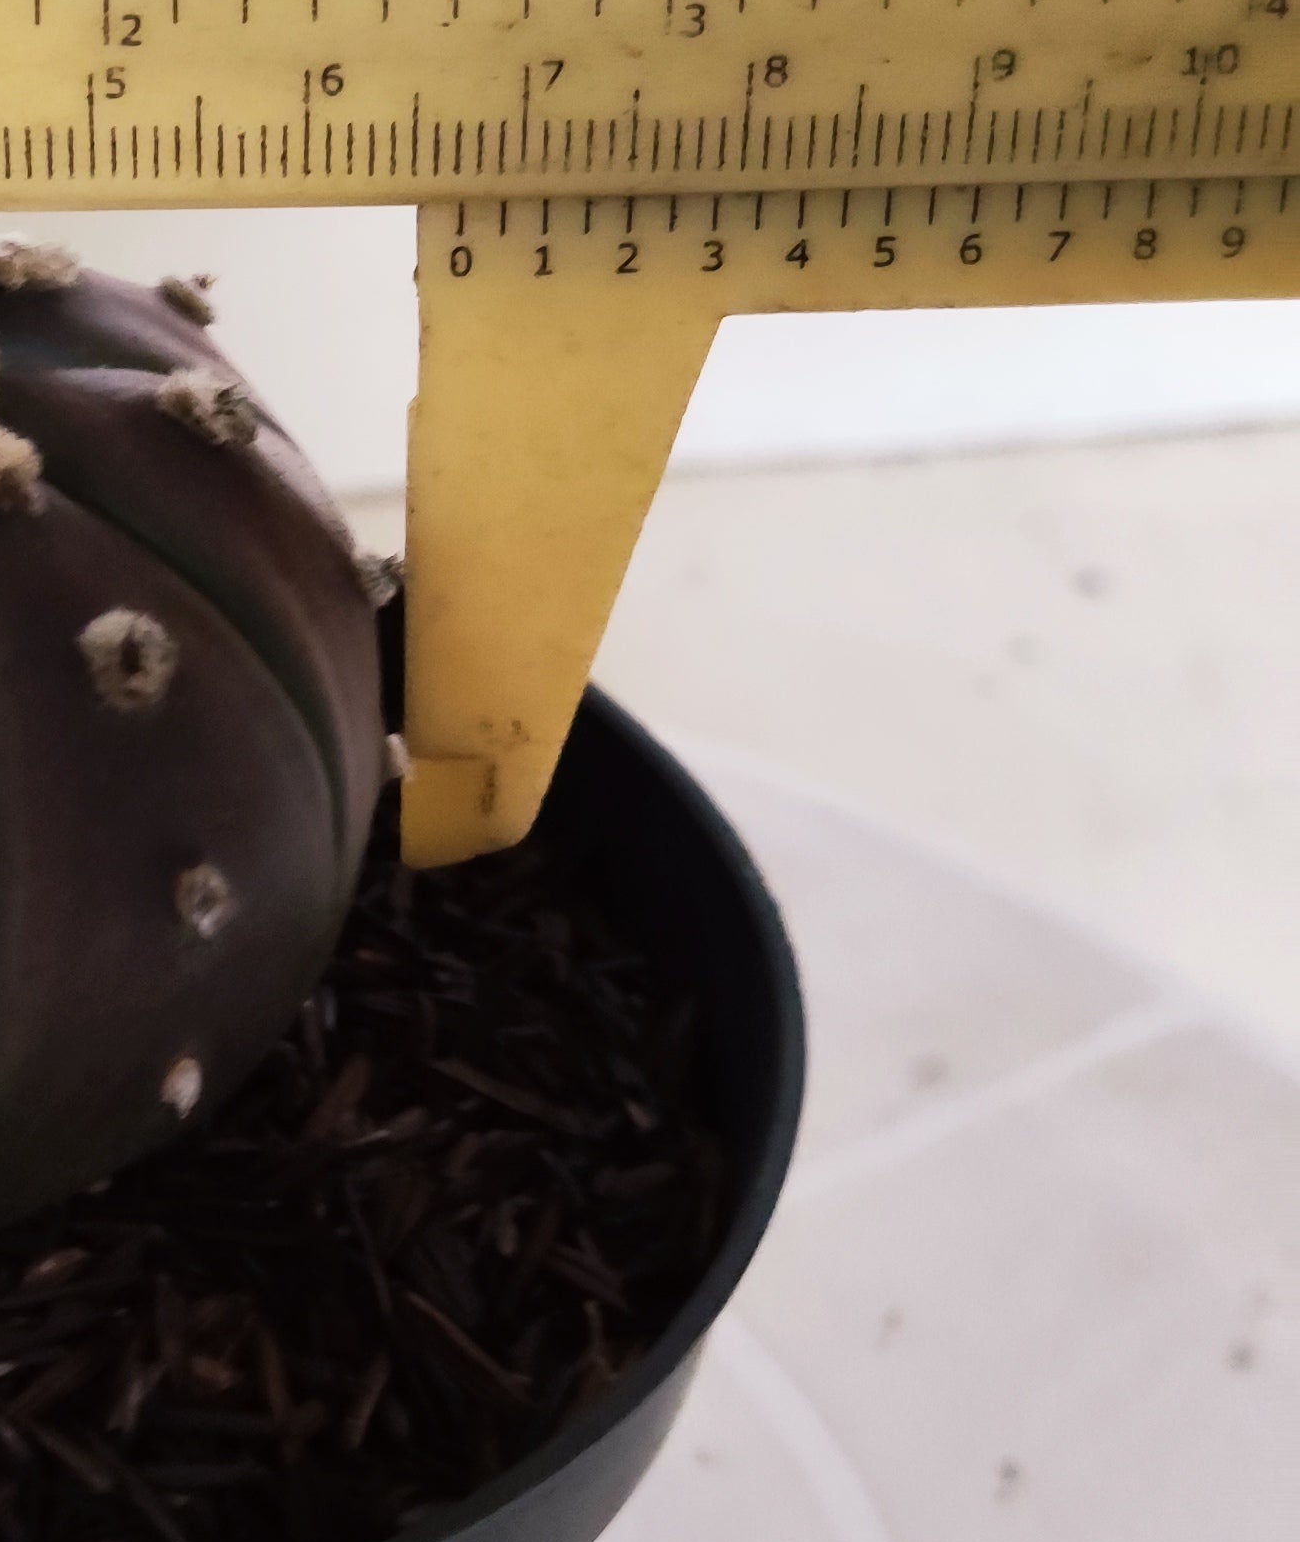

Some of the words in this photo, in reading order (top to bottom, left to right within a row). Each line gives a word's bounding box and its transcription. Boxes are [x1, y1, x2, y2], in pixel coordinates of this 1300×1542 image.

[121, 14, 142, 47] 2
[685, 4, 706, 37] 3
[105, 67, 126, 99] 5
[321, 63, 344, 96] 6
[542, 60, 564, 91] 7
[764, 56, 787, 87] 8
[992, 49, 1017, 82] 9
[1182, 44, 1239, 76] 10
[450, 246, 472, 277] 0
[534, 247, 552, 276] 1
[617, 244, 638, 273] 2
[702, 241, 724, 272] 3
[785, 239, 809, 269] 4
[874, 237, 897, 268] 5
[959, 233, 983, 264] 6
[1048, 231, 1071, 262] 7
[1133, 228, 1157, 260] 8
[1222, 226, 1245, 258] 9
